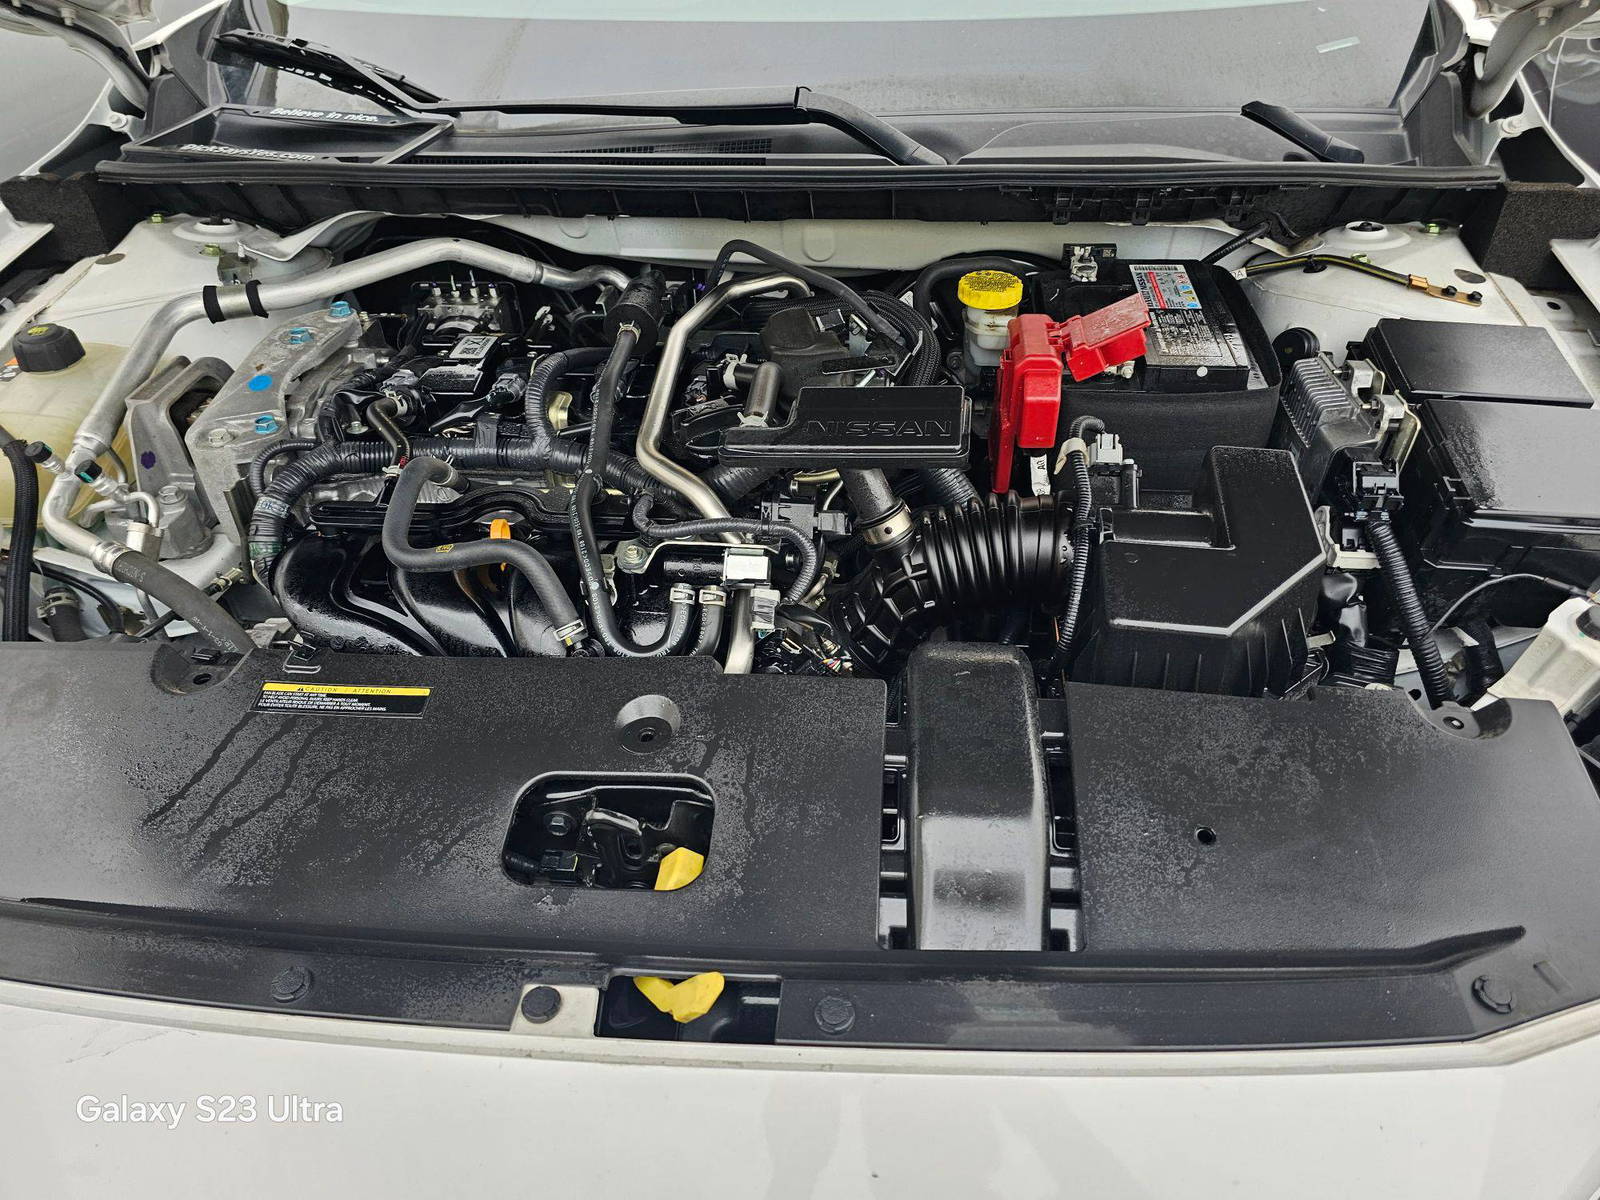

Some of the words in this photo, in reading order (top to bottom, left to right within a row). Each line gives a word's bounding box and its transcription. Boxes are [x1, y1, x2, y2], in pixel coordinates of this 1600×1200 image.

[270, 107, 323, 119] Believe
[326, 110, 340, 120] in
[344, 111, 378, 122] nice.
[803, 420, 952, 437] NISSAN
